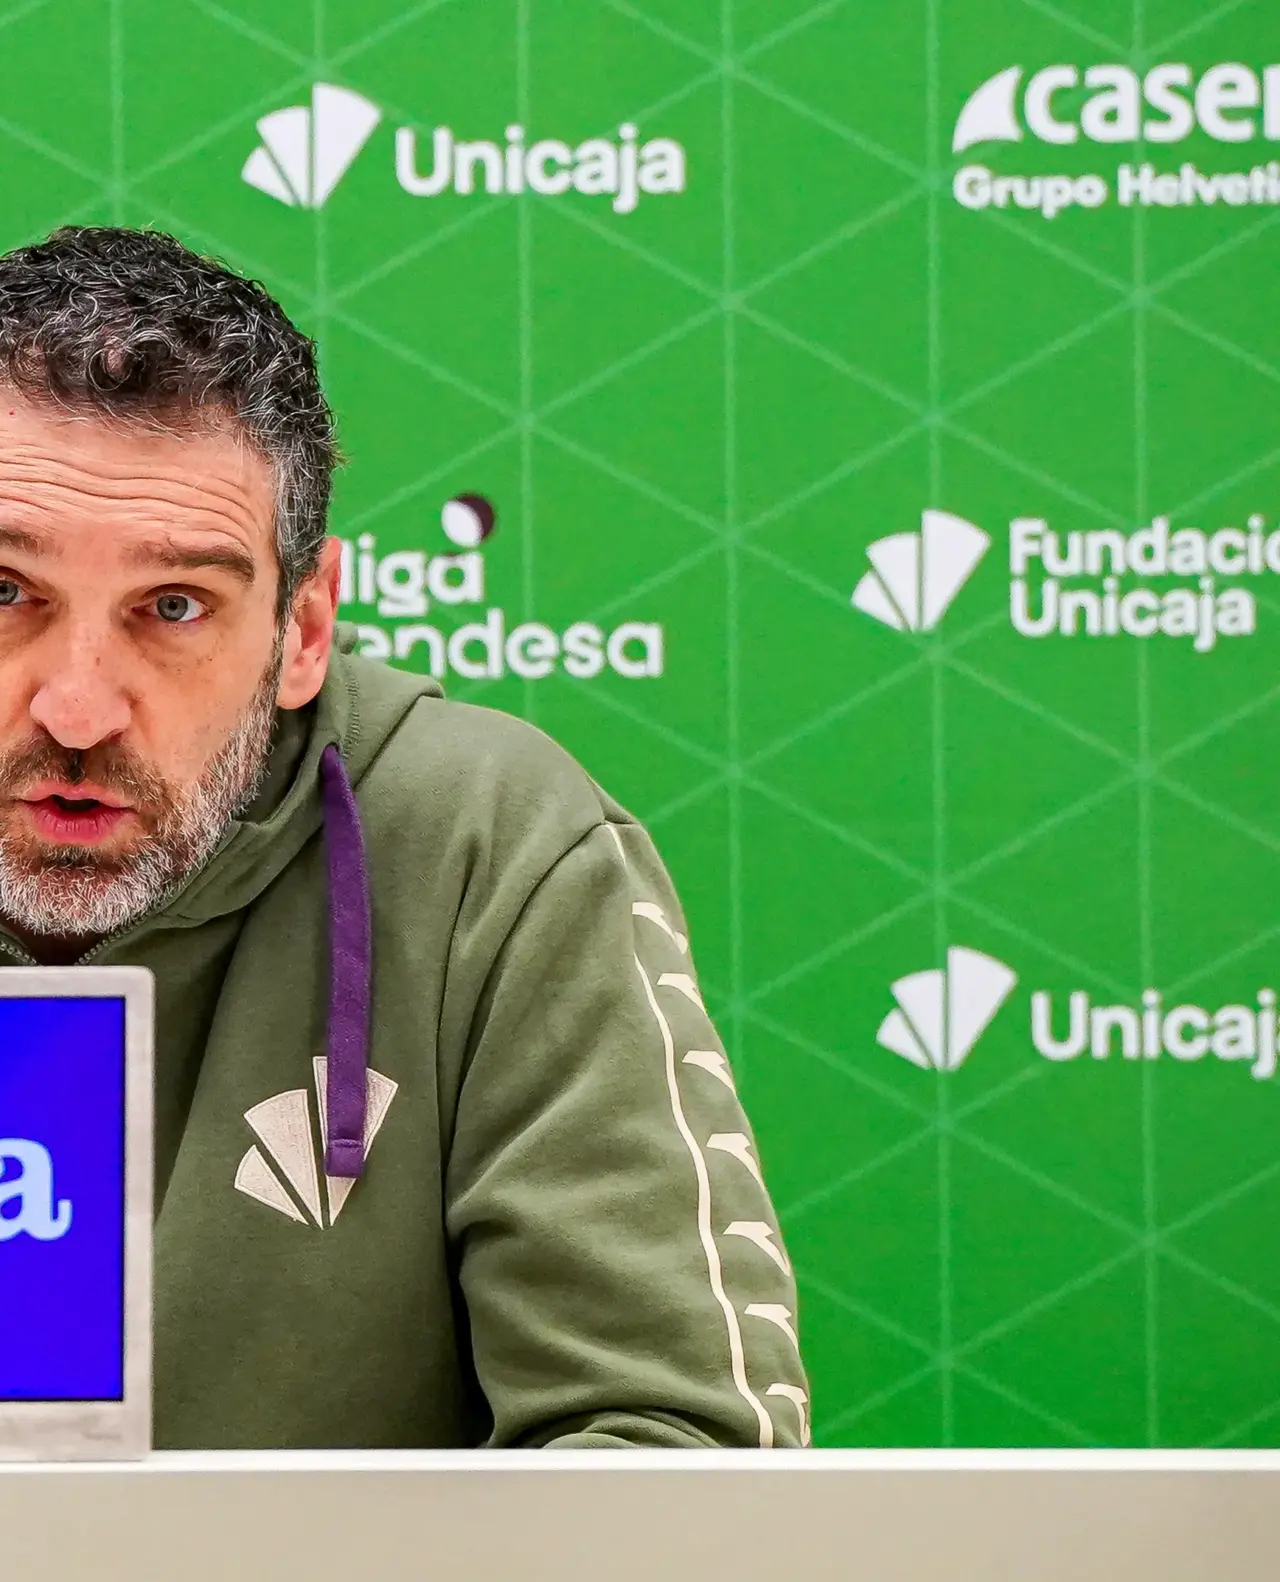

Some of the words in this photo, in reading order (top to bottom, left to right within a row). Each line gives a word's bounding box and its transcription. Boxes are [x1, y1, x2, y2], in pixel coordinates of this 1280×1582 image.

[395, 121, 686, 215] Unicaja
[952, 163, 1108, 220] Grupo
[1009, 575, 1257, 653] Unicaja
[1030, 988, 1280, 1080] Unicaj
